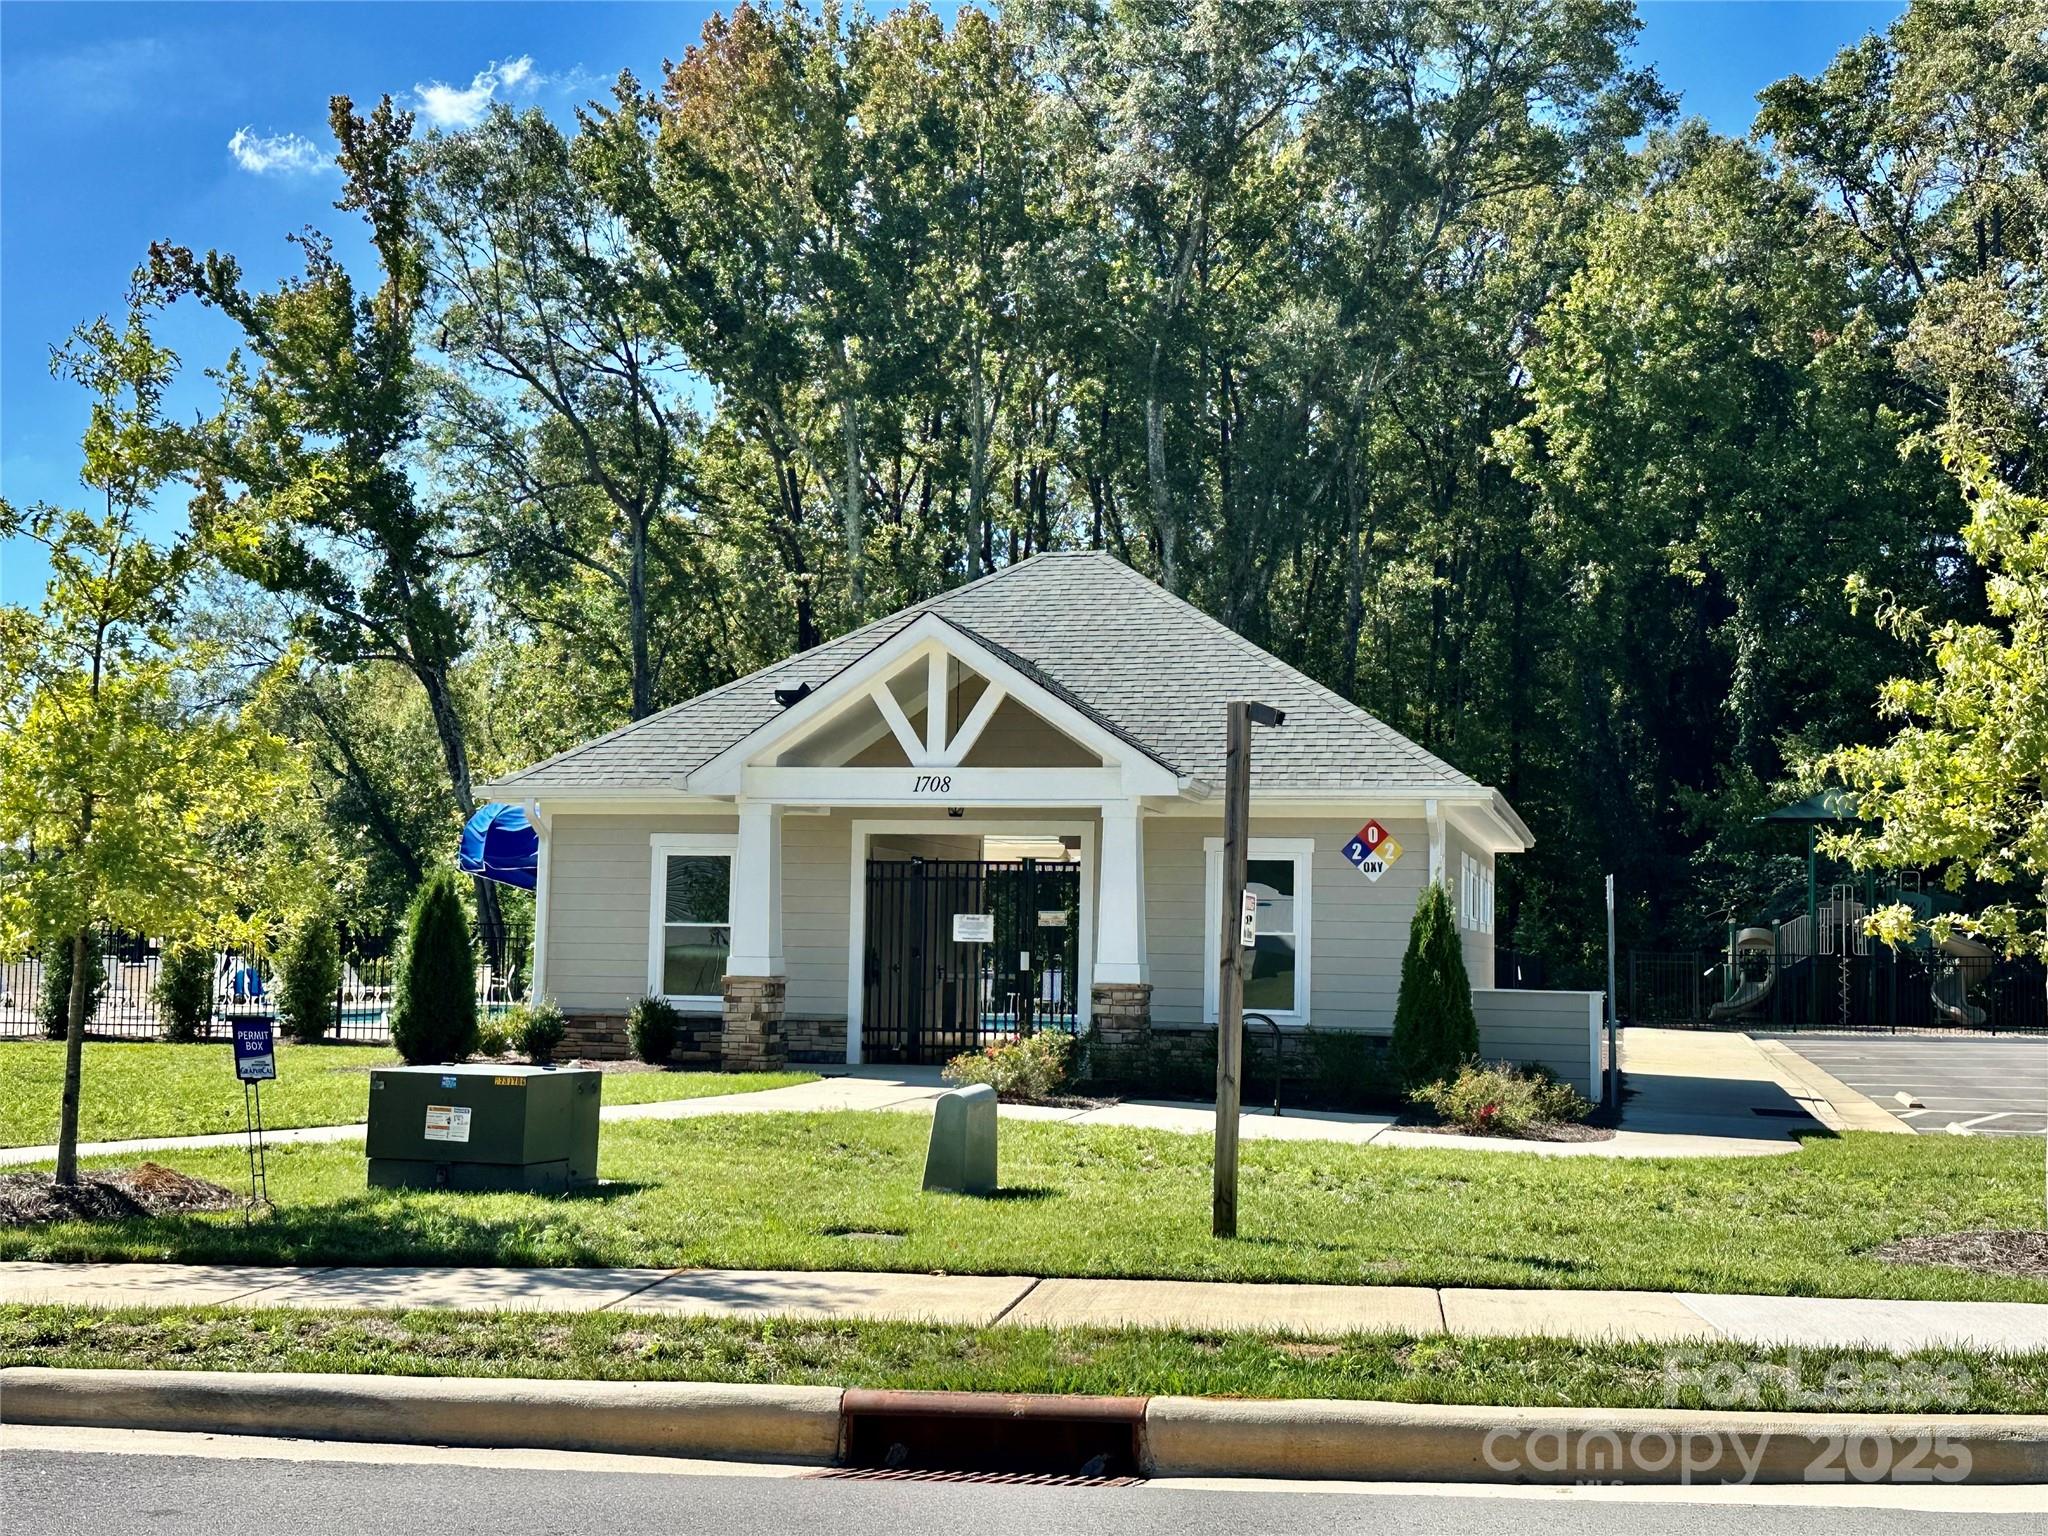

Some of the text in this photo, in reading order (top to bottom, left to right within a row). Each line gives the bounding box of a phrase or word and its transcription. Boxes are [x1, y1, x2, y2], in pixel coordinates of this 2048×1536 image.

[913, 776, 951, 792] 1708
[1367, 826, 1379, 843] 0
[1352, 843, 1395, 860] 2 2
[1363, 862, 1383, 873] OXY
[238, 1031, 269, 1040] PERMIT
[245, 1041, 263, 1051] BOX
